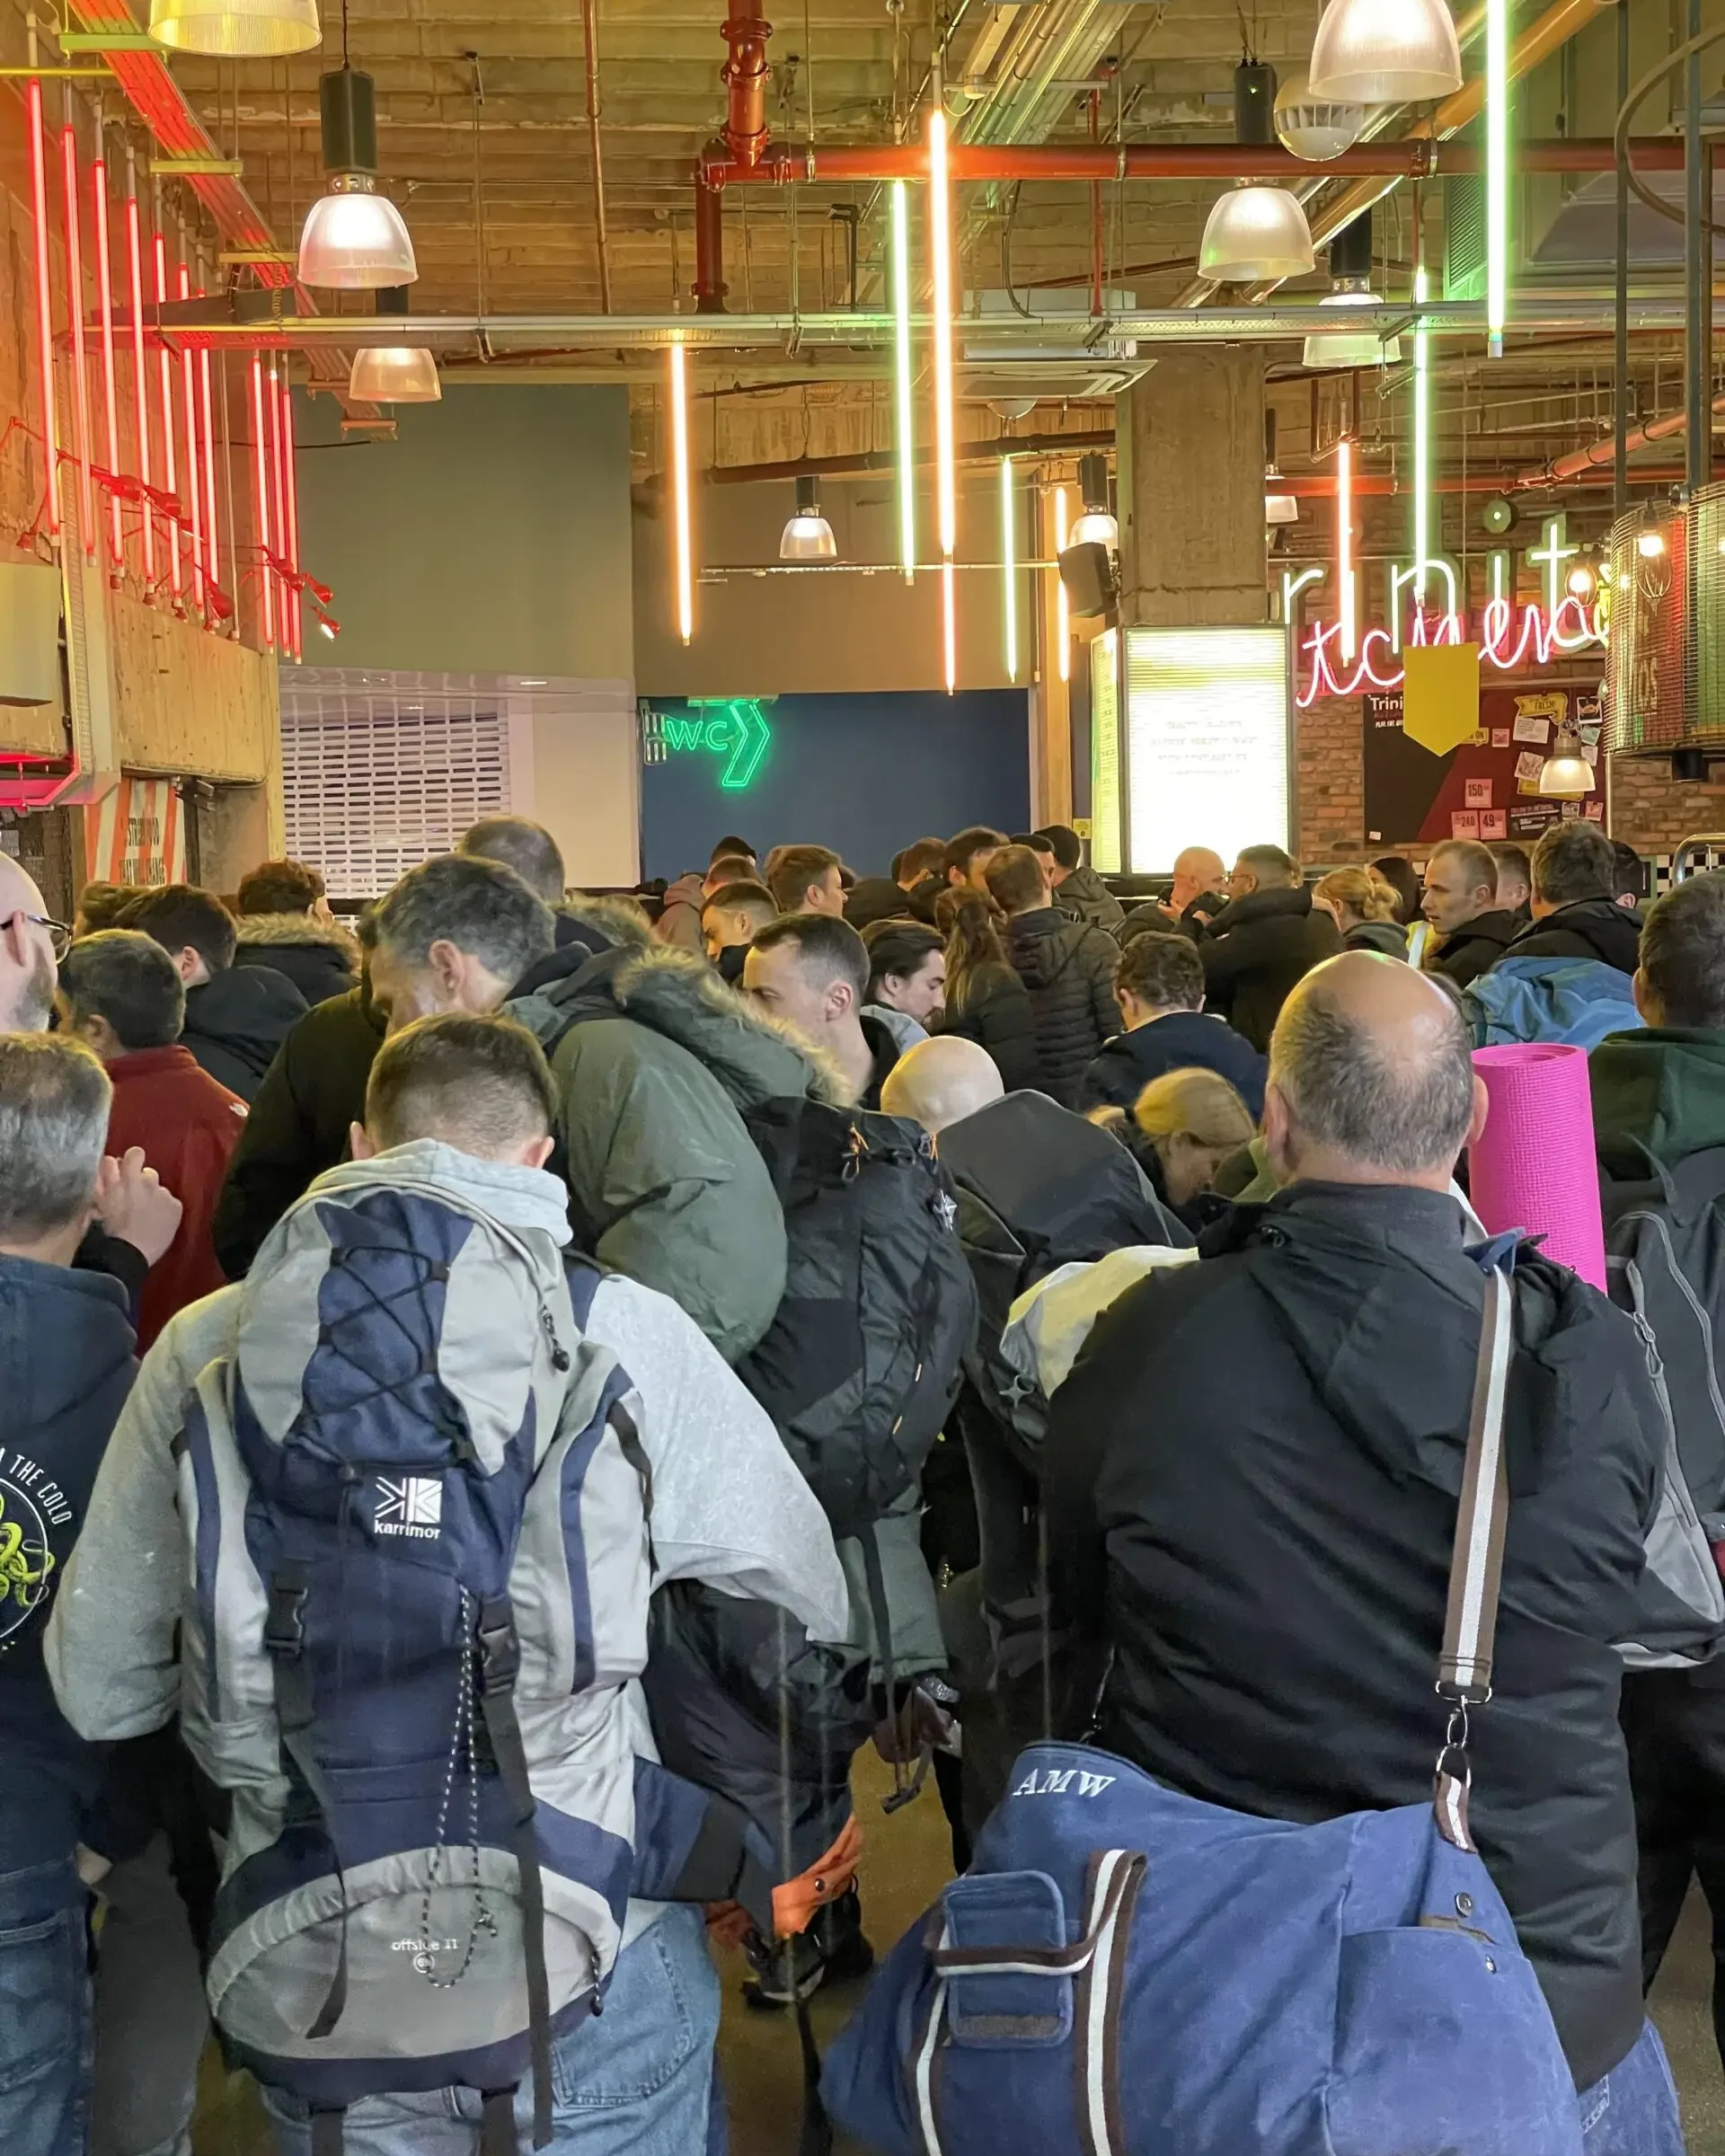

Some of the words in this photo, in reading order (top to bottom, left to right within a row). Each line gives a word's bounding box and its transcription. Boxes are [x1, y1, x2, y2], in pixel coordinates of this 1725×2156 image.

[1370, 695, 1403, 711] Trini
[666, 720, 728, 751] WC
[10, 1454, 44, 1487] THE
[37, 1482, 73, 1525] COLD
[374, 1519, 441, 1540] karrimor
[1013, 1768, 1117, 1798] AMW
